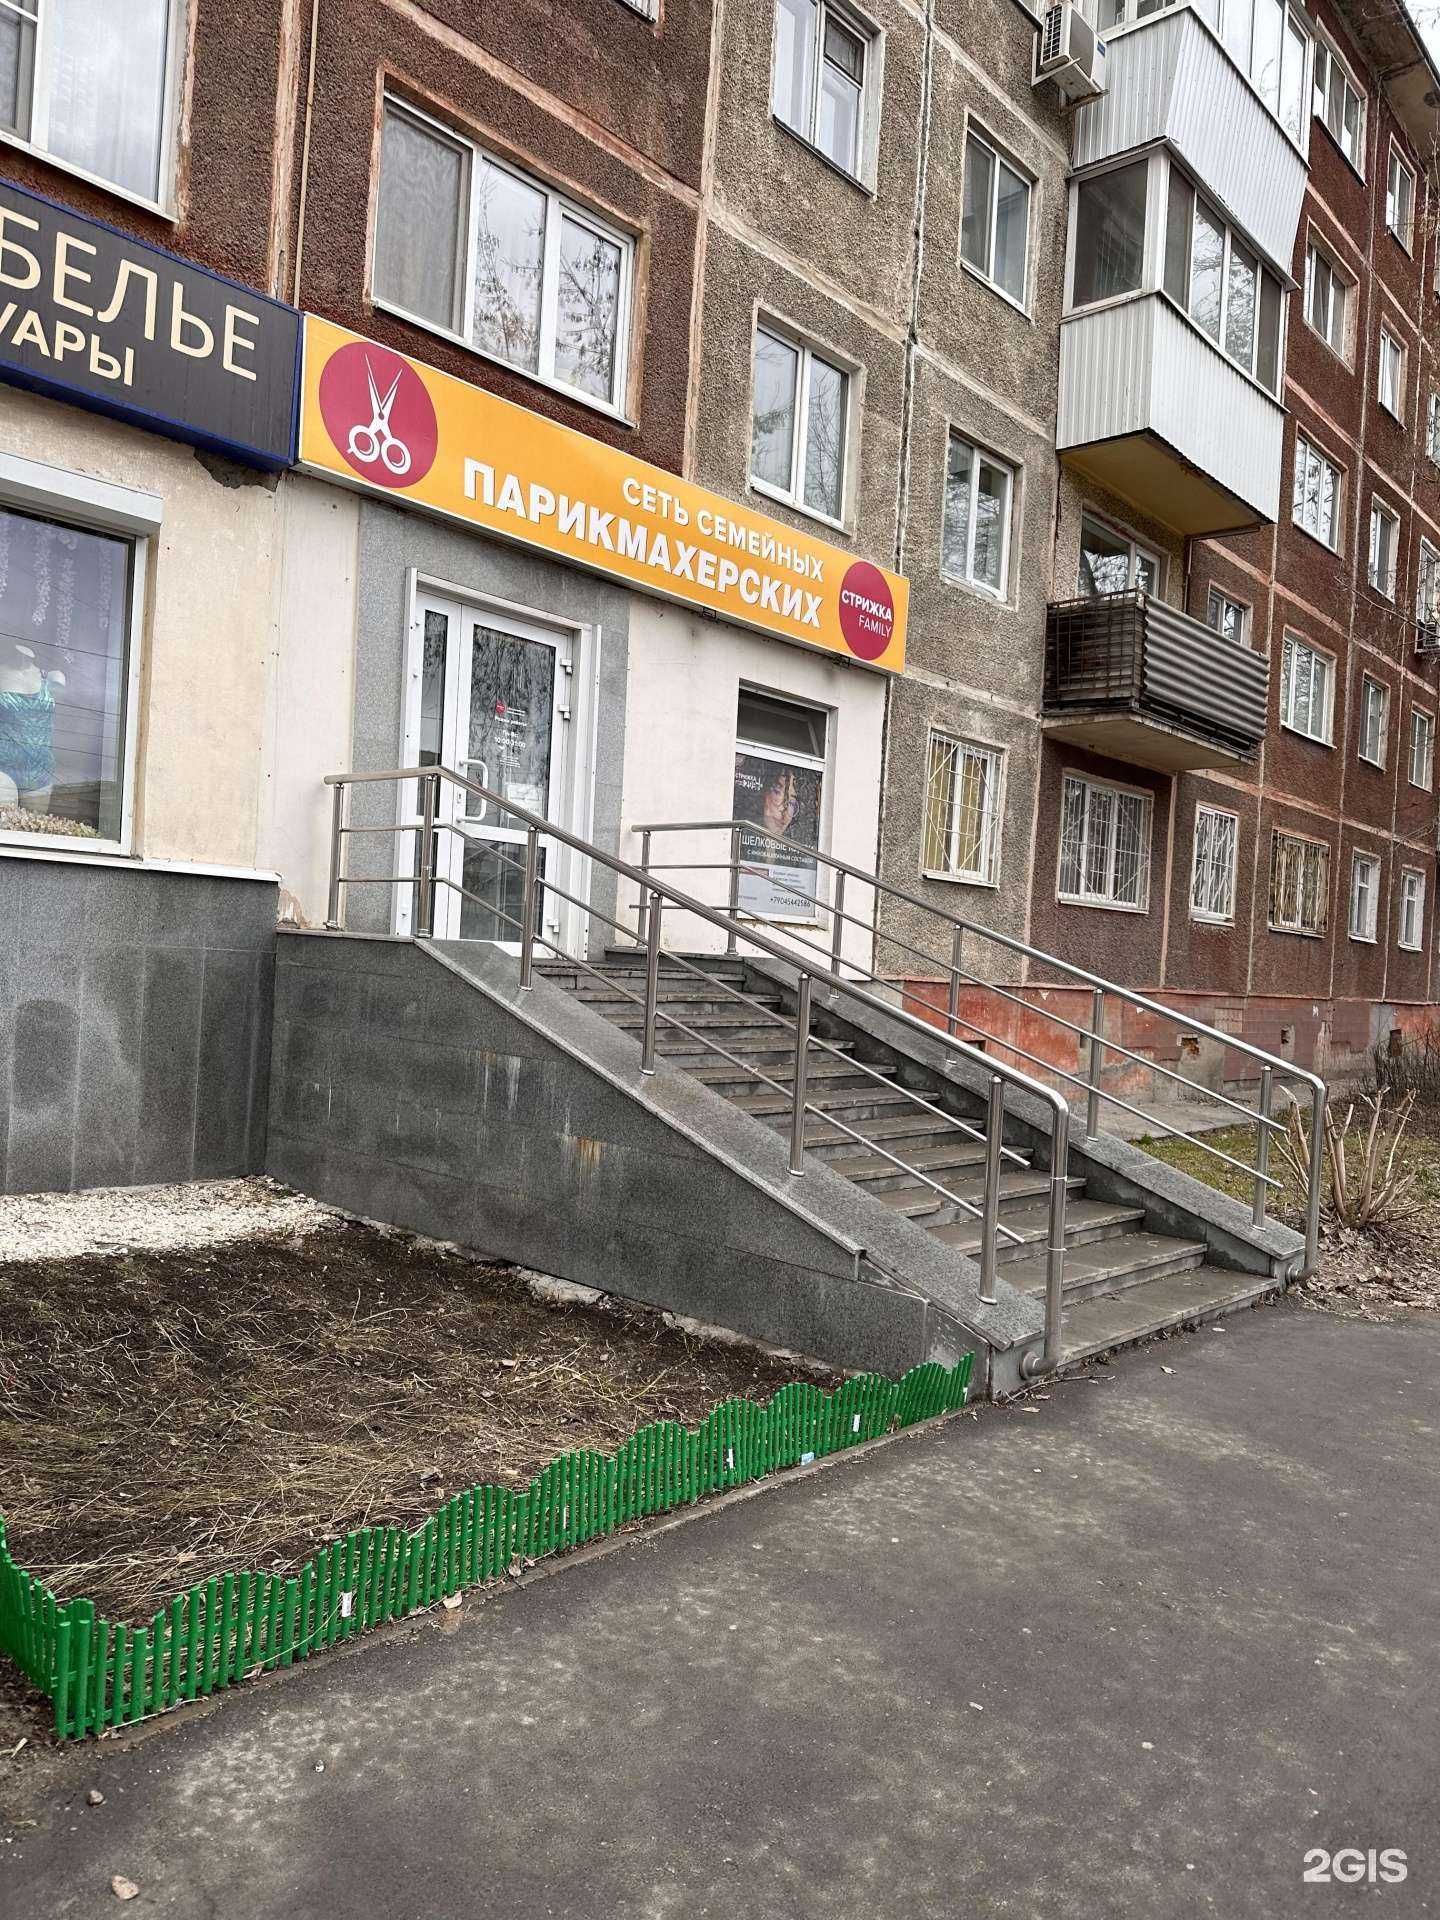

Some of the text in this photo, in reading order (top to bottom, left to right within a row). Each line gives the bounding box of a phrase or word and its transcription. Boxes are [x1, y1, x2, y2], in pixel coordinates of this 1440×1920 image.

[0, 206, 260, 382] БЕЛЬЕ
[463, 456, 823, 629] ПАРИКМАХЕРСКИХ
[622, 477, 826, 583] СЕТЬ СЕМЕЙНЫХ
[841, 589, 893, 622] СТРИЖКА
[859, 614, 892, 638] FAMILY
